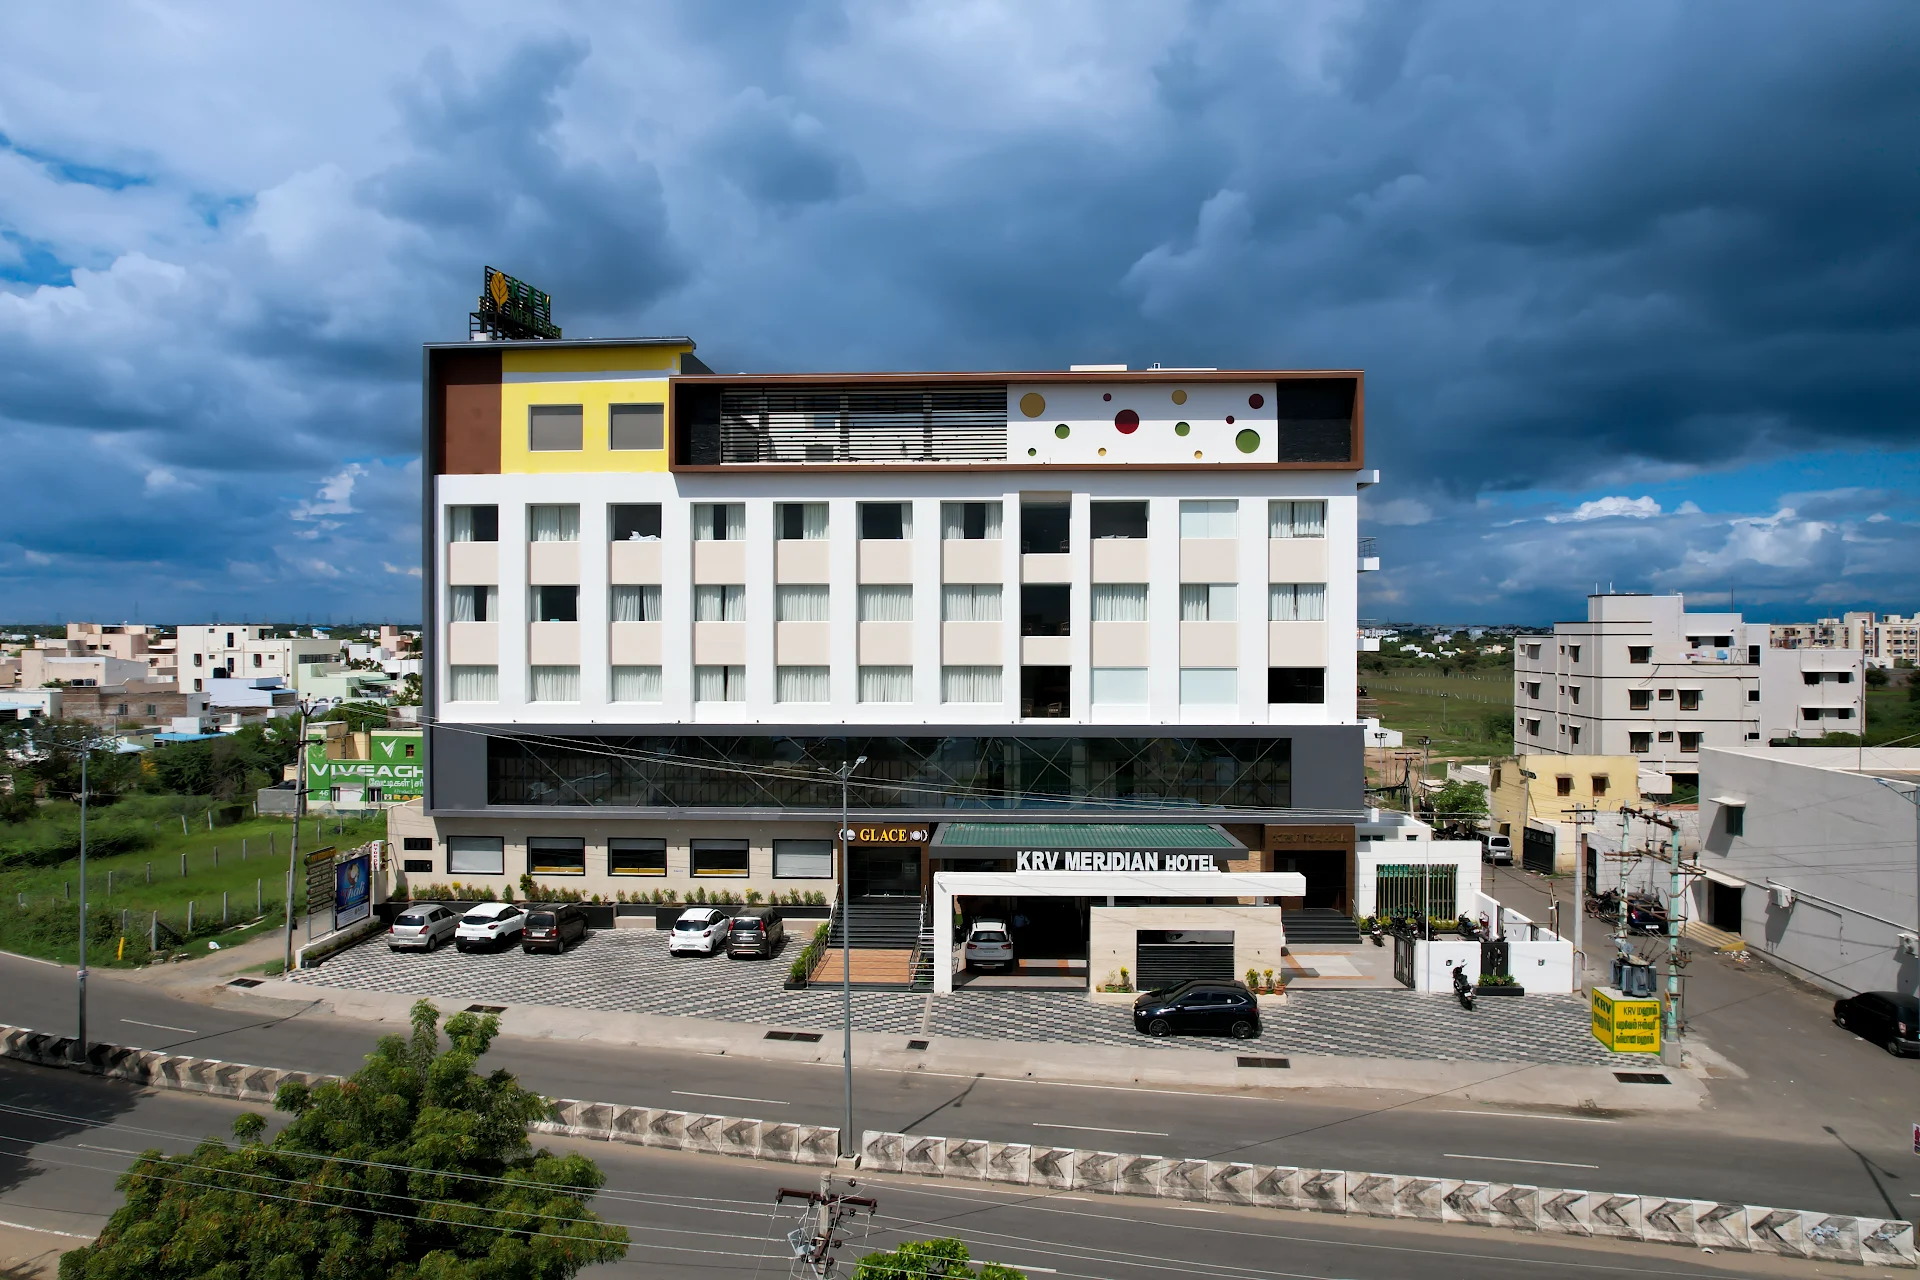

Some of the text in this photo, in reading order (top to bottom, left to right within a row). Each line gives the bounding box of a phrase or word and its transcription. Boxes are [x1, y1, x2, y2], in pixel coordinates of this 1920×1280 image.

[511, 276, 550, 313] KRV
[859, 828, 907, 842] GLACE
[1016, 851, 1219, 871] KRV MERIDIAN HOTEL
[1594, 995, 1611, 1014] KRV
[1624, 1007, 1636, 1015] KRV
